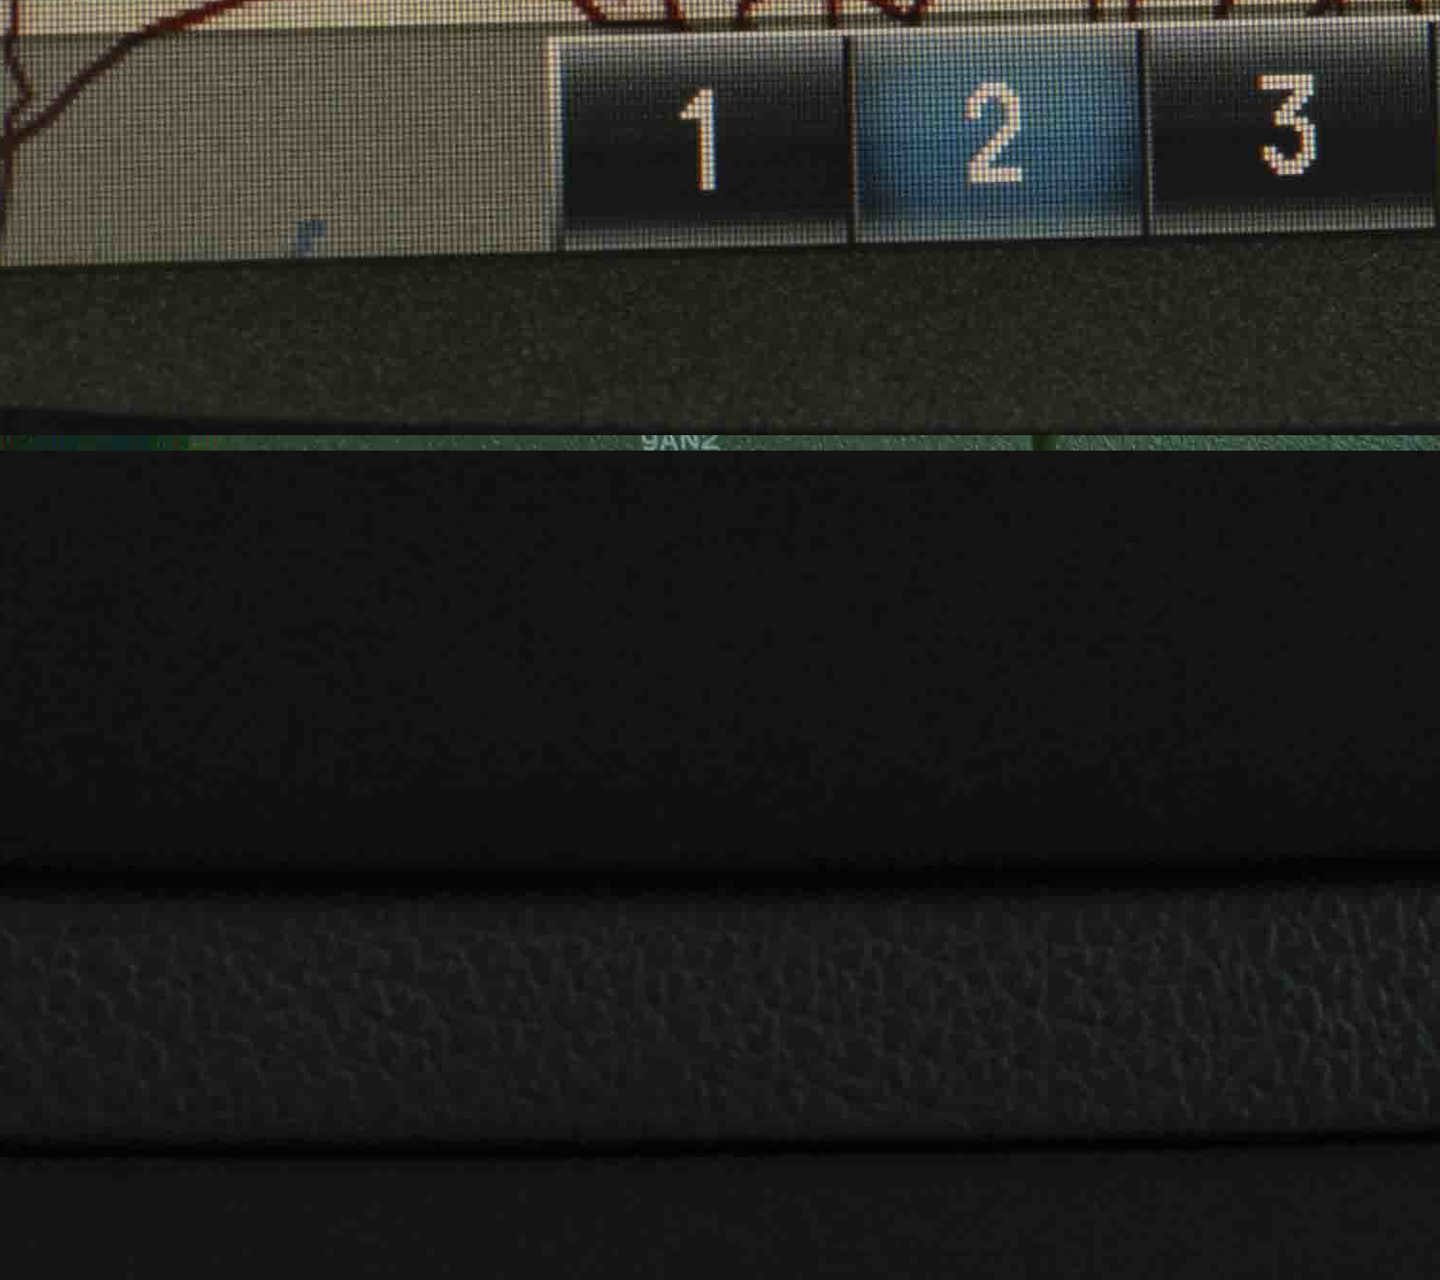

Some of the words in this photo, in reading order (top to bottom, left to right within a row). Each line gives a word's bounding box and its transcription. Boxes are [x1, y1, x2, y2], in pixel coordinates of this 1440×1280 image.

[679, 86, 718, 192] 1
[964, 81, 1024, 184] 2
[1255, 72, 1318, 176] 3
